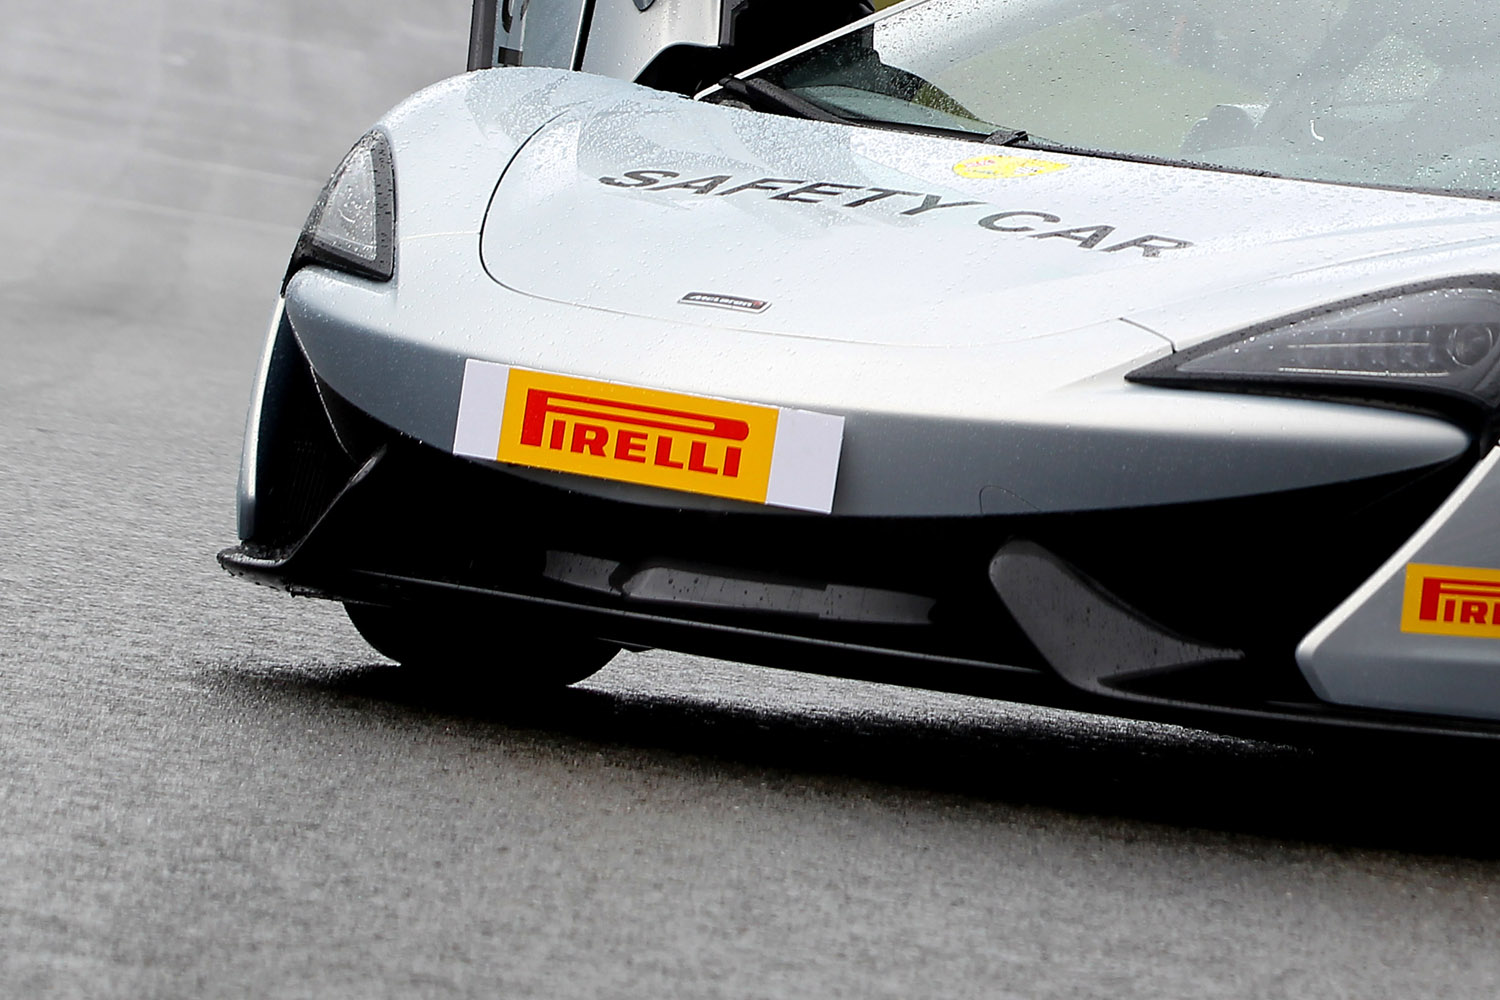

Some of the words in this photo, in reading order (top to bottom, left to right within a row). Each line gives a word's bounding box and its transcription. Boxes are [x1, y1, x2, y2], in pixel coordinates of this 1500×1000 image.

[599, 168, 988, 216] SAFETY
[978, 210, 1196, 258] CAR
[520, 388, 749, 478] PIRELLI
